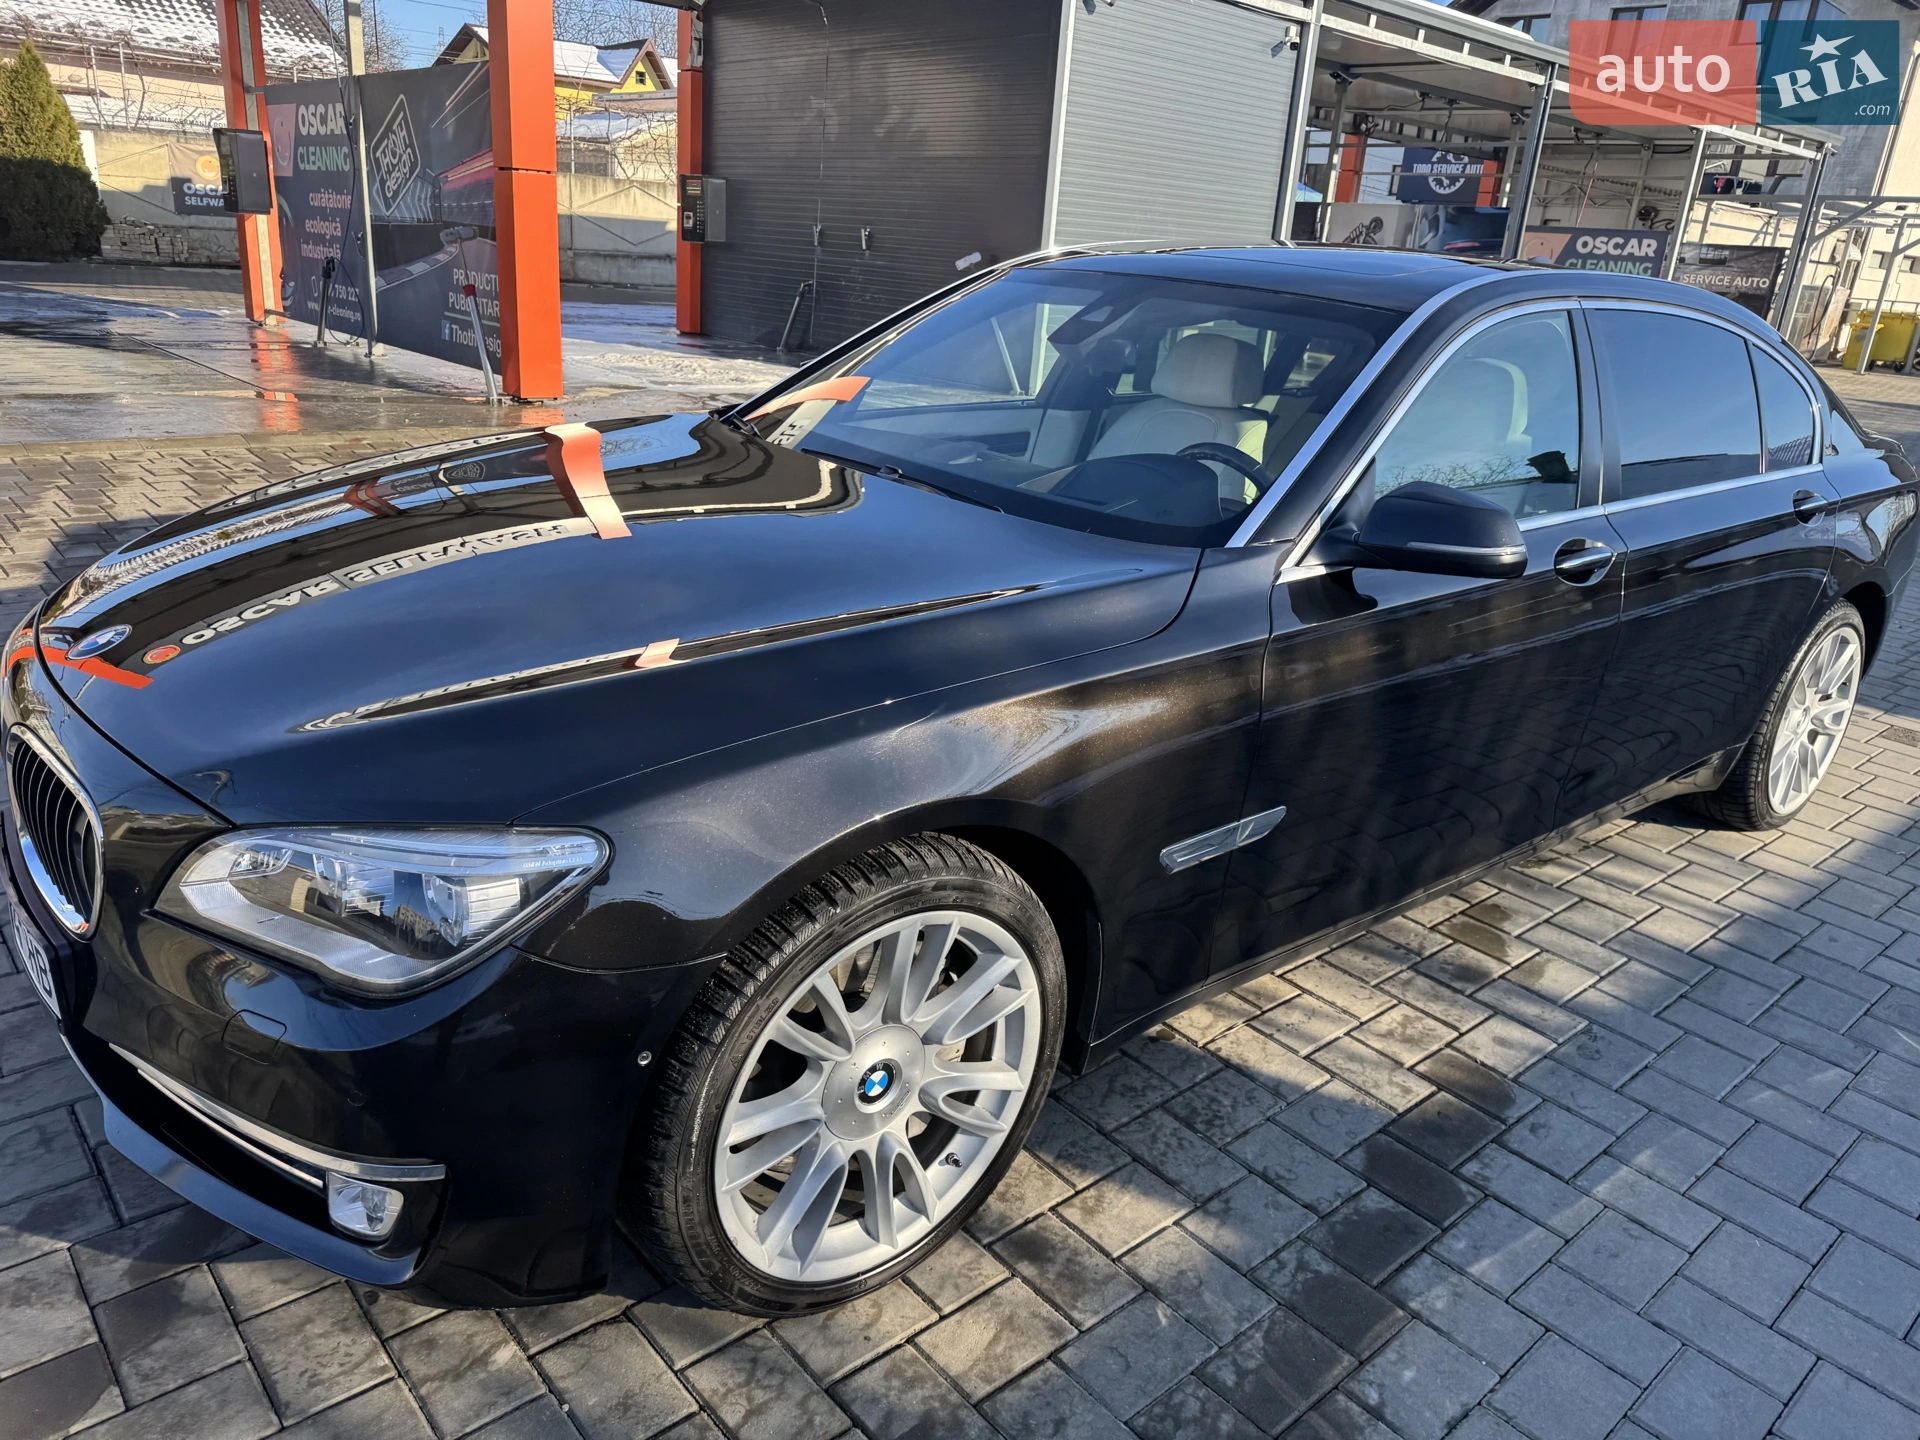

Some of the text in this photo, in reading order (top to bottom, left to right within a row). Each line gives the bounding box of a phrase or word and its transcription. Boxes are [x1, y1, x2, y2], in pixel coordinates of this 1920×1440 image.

[298, 102, 347, 136] OSCAR
[297, 146, 350, 172] CLEANING
[1432, 163, 1463, 174] SERVICE
[384, 147, 415, 198] design
[1575, 235, 1658, 257] OSCAR
[1564, 257, 1653, 277] CLEANING
[1682, 273, 1770, 289] SERVICE AUTO
[857, 1062, 885, 1094] BMW
